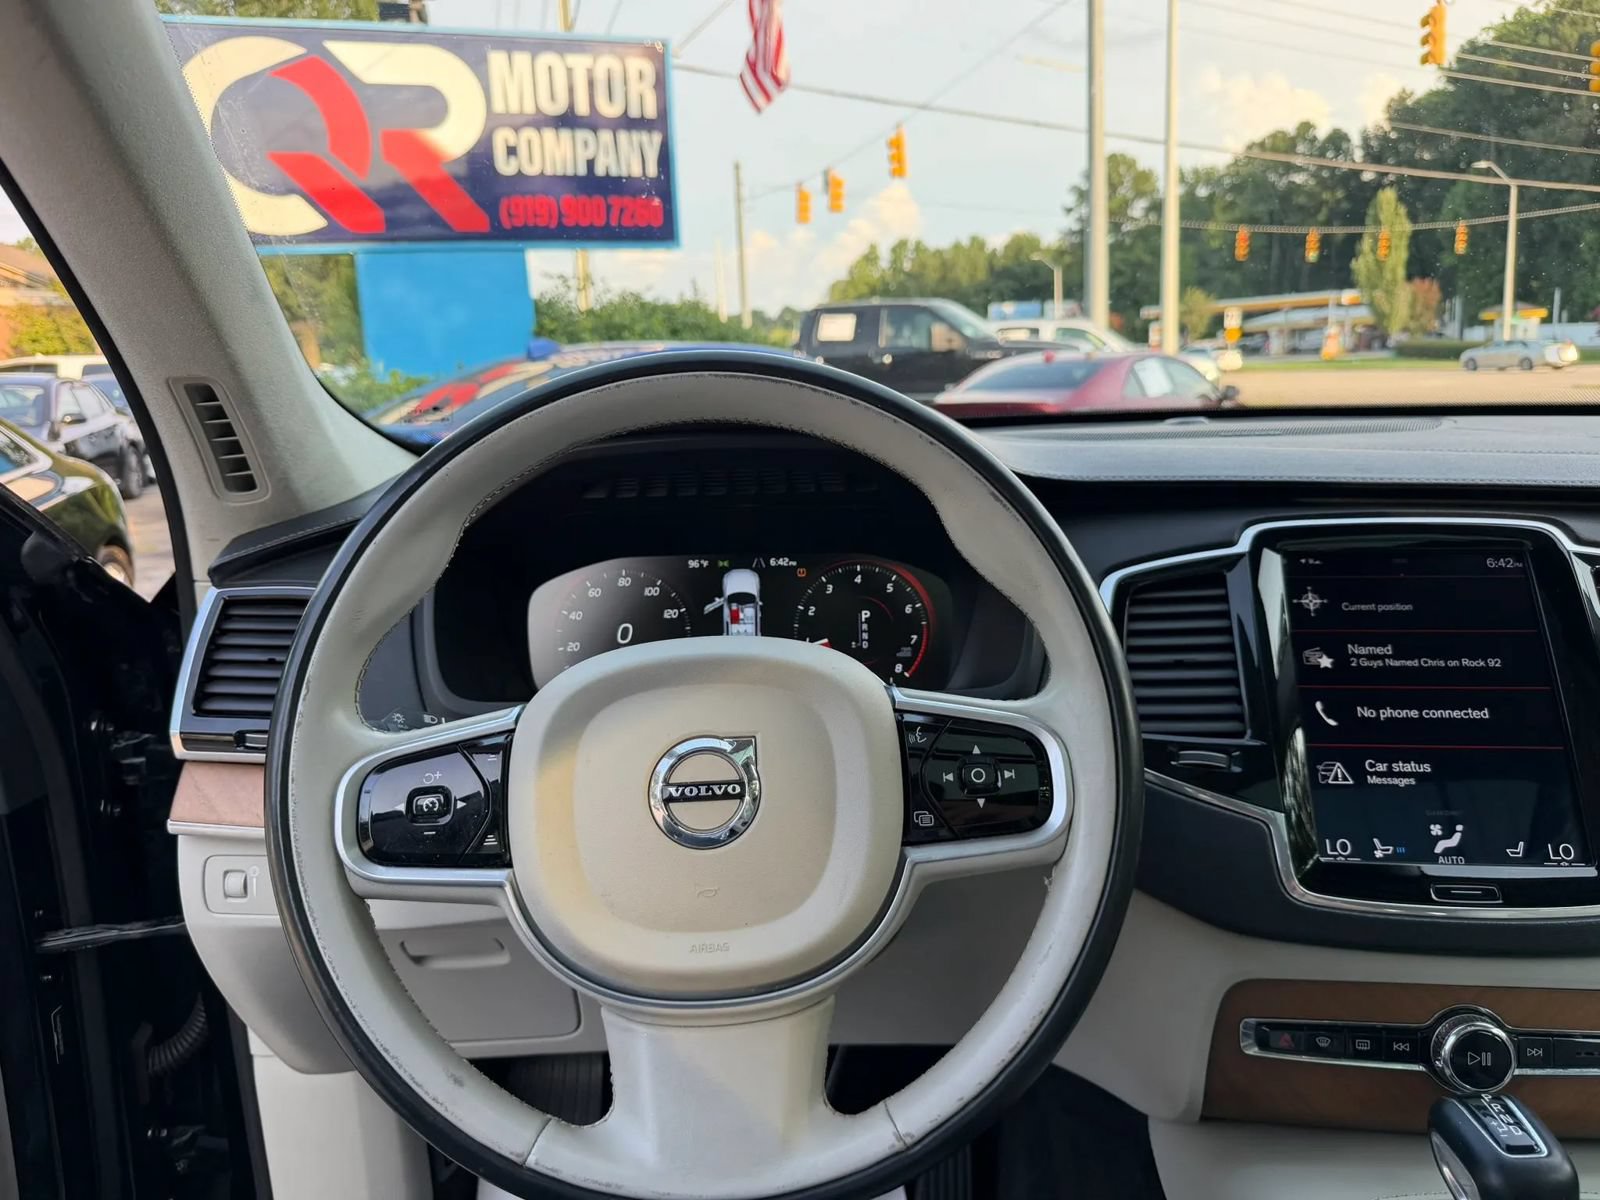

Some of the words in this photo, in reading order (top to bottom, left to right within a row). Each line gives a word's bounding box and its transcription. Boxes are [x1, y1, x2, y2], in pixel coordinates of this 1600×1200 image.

[488, 50, 658, 120] MOTOR
[492, 126, 663, 178] COMPANY
[499, 194, 559, 230] (919)
[560, 193, 607, 228] 900
[617, 576, 632, 588] 80
[854, 574, 862, 584] 4
[588, 587, 602, 598] 60
[644, 586, 660, 597] 100
[825, 584, 833, 594] 3
[886, 583, 894, 593] 5
[807, 606, 816, 616] 2
[904, 604, 913, 614] 6
[1341, 602, 1376, 612] Current
[1377, 603, 1413, 613] position
[569, 610, 583, 621] 40
[663, 608, 679, 619] 120
[861, 610, 871, 622] P
[616, 623, 633, 644] 0
[909, 635, 918, 645] 7
[566, 642, 580, 652] 20
[1347, 644, 1393, 655] Named
[894, 663, 903, 674] 8
[1349, 658, 1357, 666] 2
[1359, 658, 1383, 668] Guys
[1384, 658, 1418, 667] Named
[1420, 658, 1445, 667] Chris
[1461, 658, 1486, 667] Rock
[1487, 658, 1502, 668] 92
[1356, 706, 1376, 718] No
[1379, 707, 1419, 720] phone
[1422, 707, 1490, 719] connected
[1365, 759, 1388, 772] Car
[1391, 760, 1432, 773] status
[1367, 775, 1416, 786] Messages
[667, 783, 741, 798] VOLVO
[1325, 838, 1351, 856] LO
[1547, 843, 1575, 861] LO
[1438, 855, 1465, 865] AUTO
[1481, 1093, 1492, 1102] P
[1491, 1103, 1504, 1112] R
[1500, 1113, 1514, 1123] N
[1509, 1125, 1522, 1135] D
